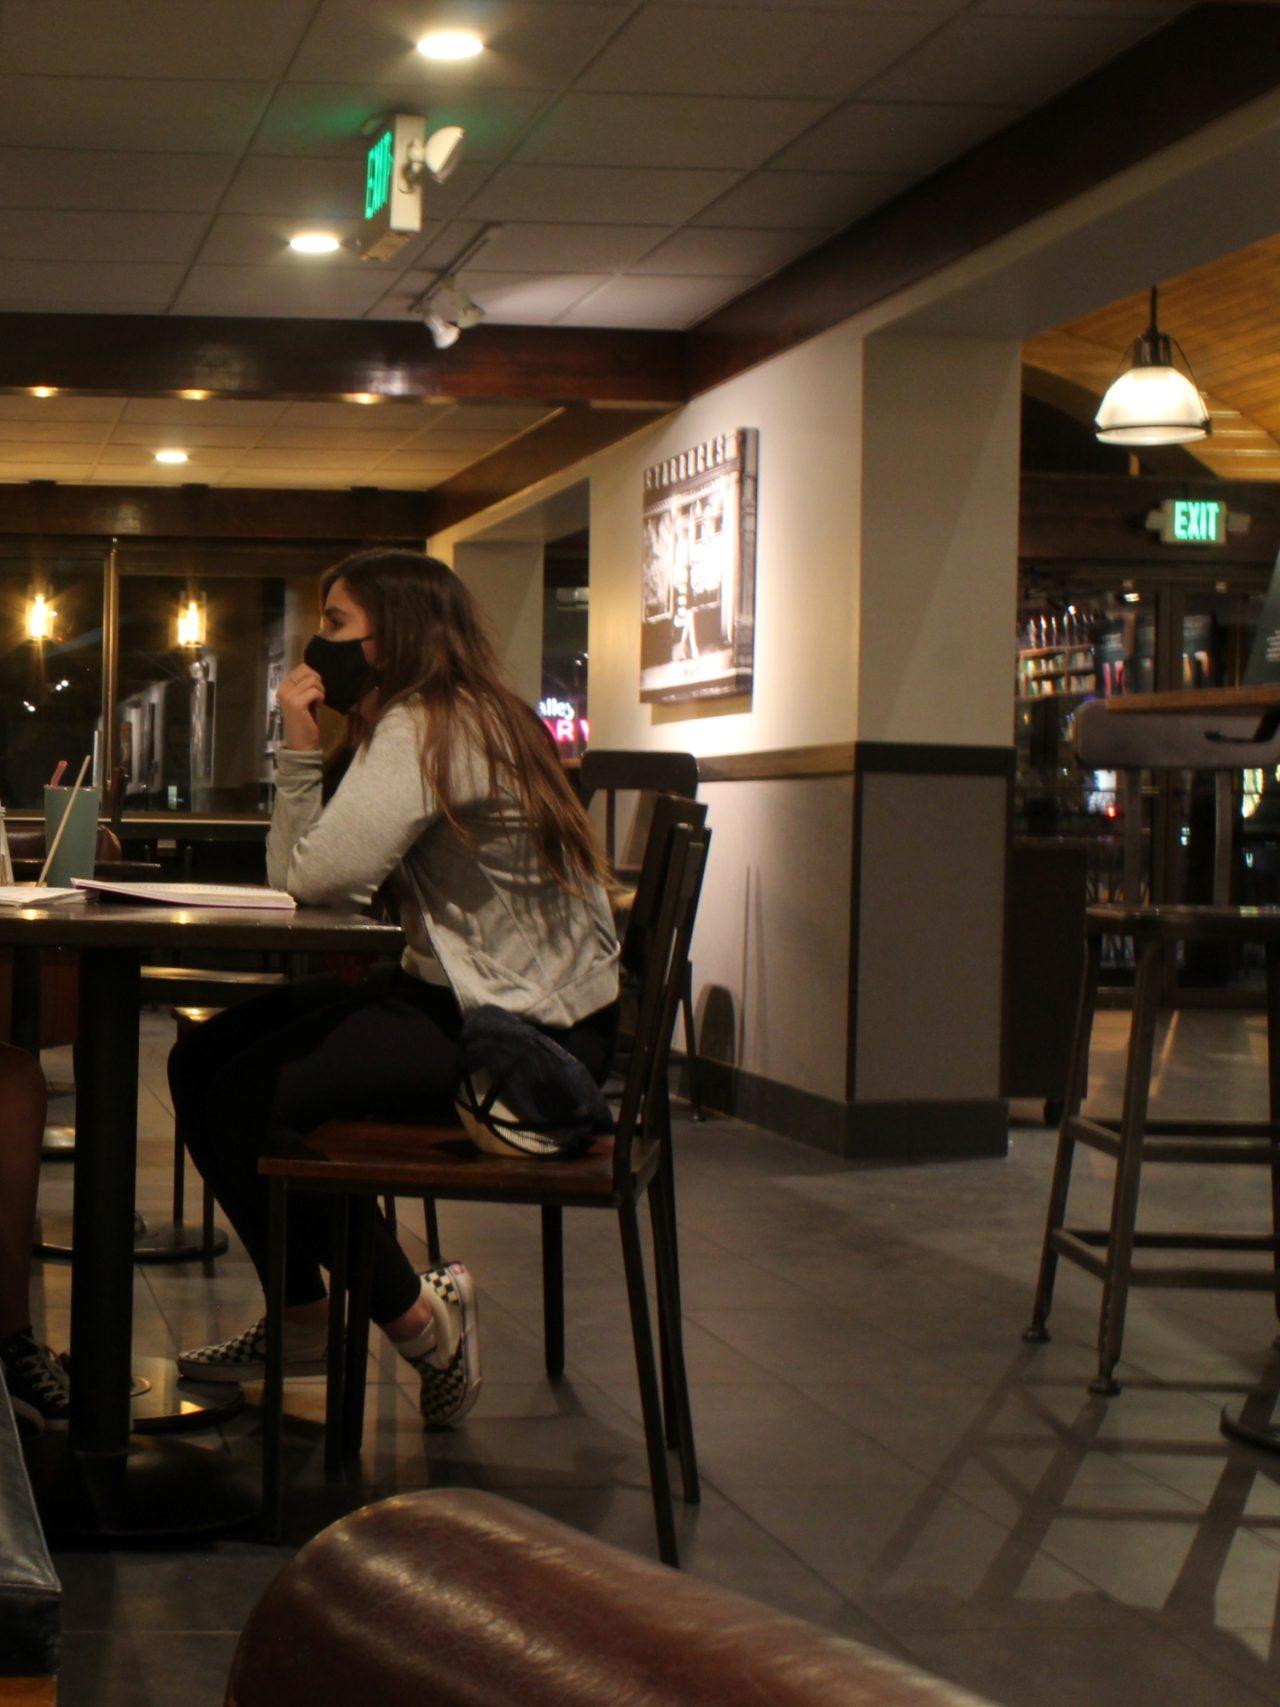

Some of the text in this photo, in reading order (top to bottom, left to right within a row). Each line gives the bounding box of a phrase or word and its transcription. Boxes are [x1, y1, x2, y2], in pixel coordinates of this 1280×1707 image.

[365, 131, 393, 219] EXIT
[645, 434, 726, 491] STARBUCKS
[1174, 500, 1220, 541] EXIT
[538, 697, 575, 721] alley
